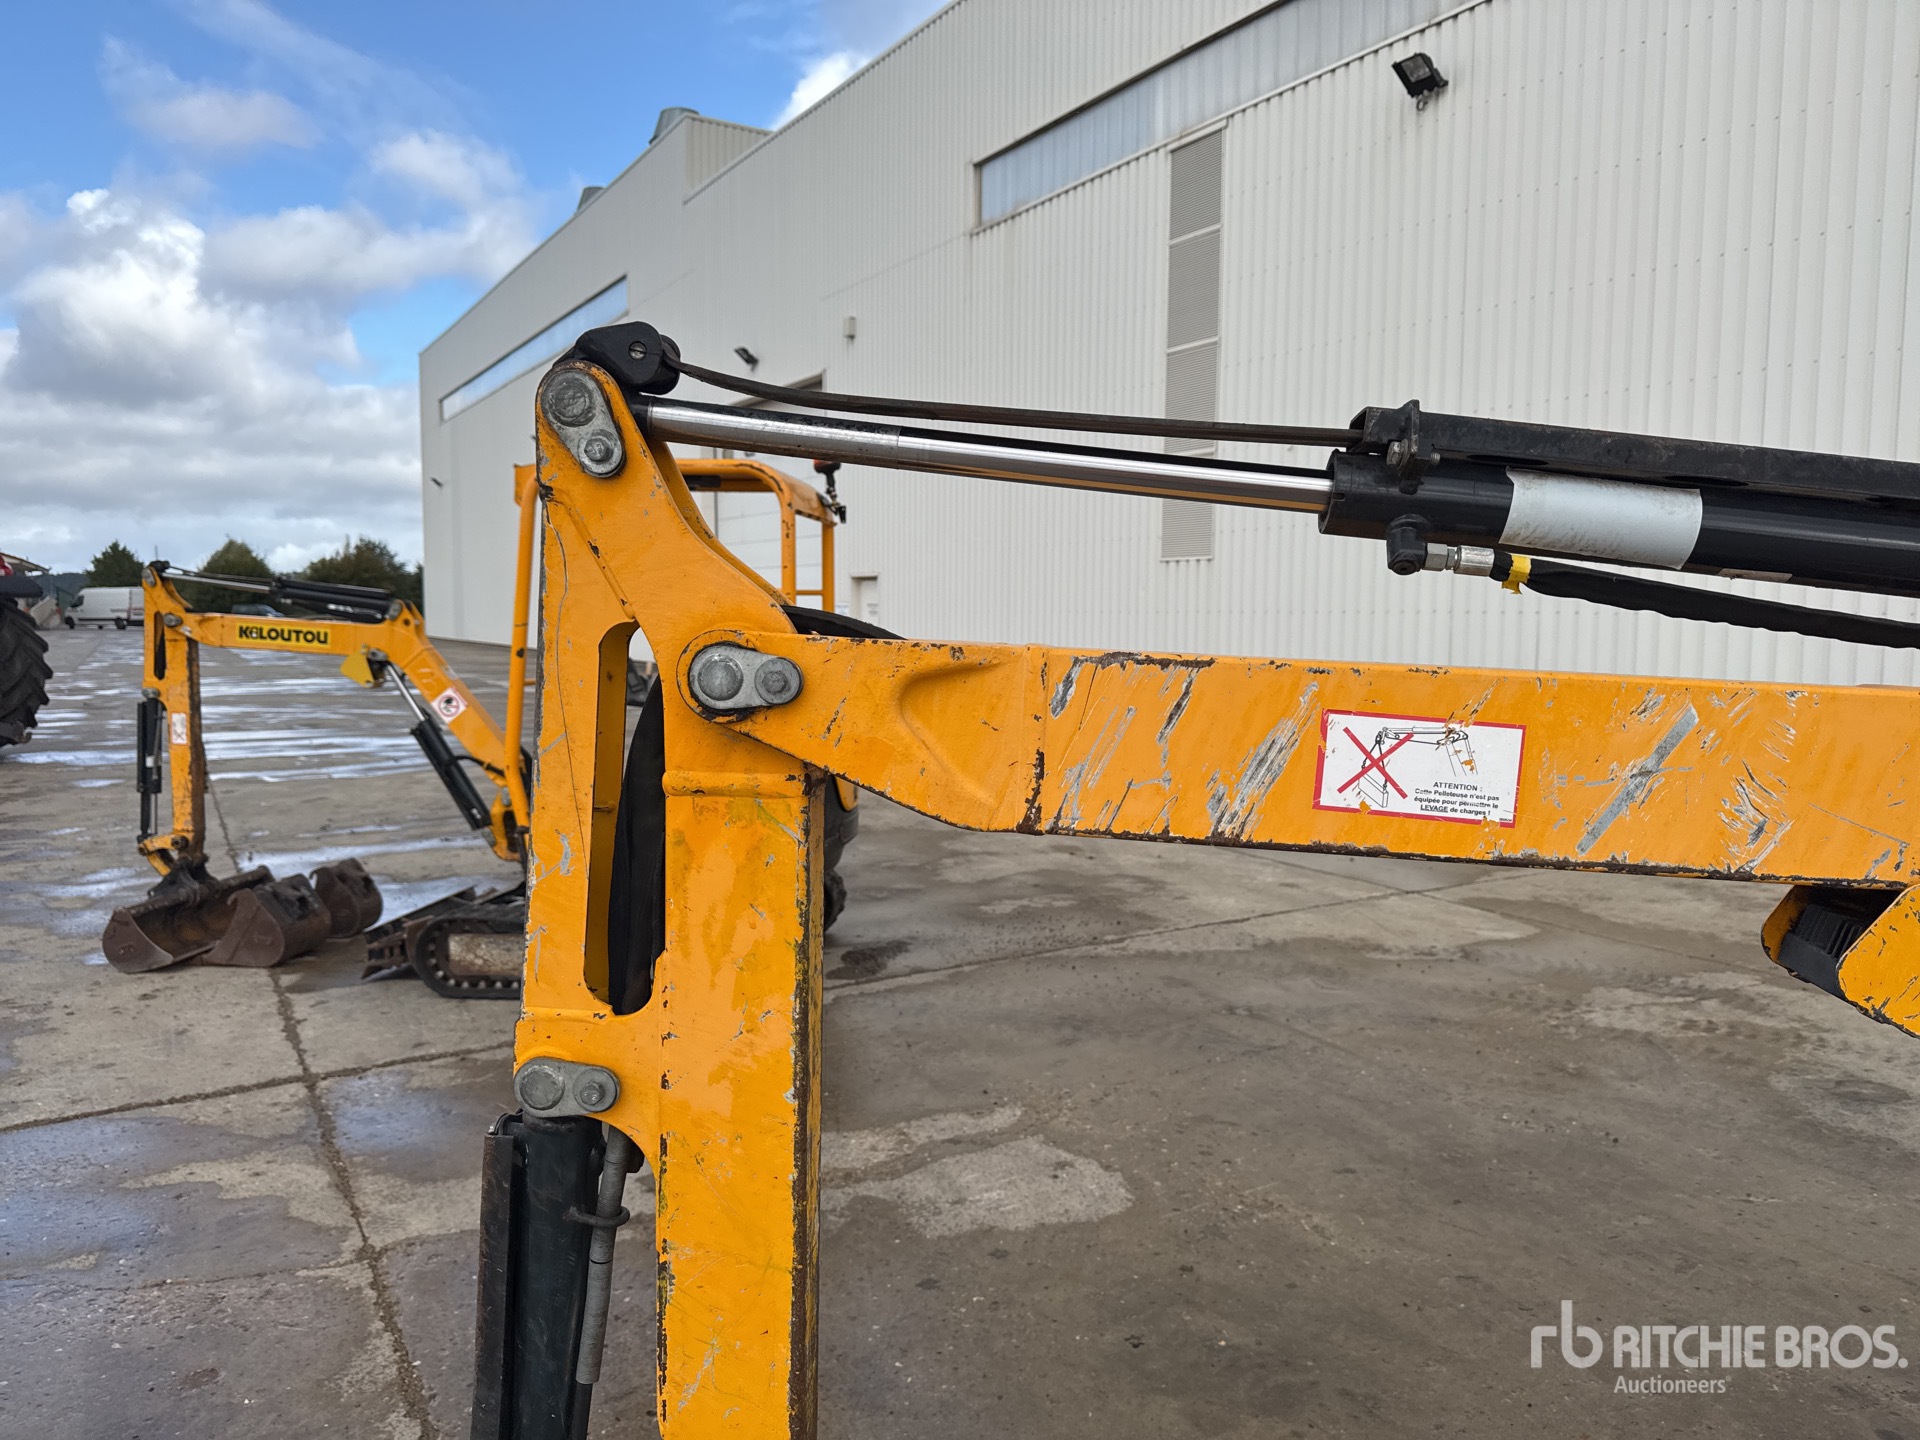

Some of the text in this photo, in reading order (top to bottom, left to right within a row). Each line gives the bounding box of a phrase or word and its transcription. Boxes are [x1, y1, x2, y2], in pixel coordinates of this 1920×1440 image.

[1433, 782, 1478, 791] ATTENTION
[1414, 795, 1441, 804] équipée
[1420, 804, 1448, 812] LEVAGE
[1460, 808, 1486, 816] charges
